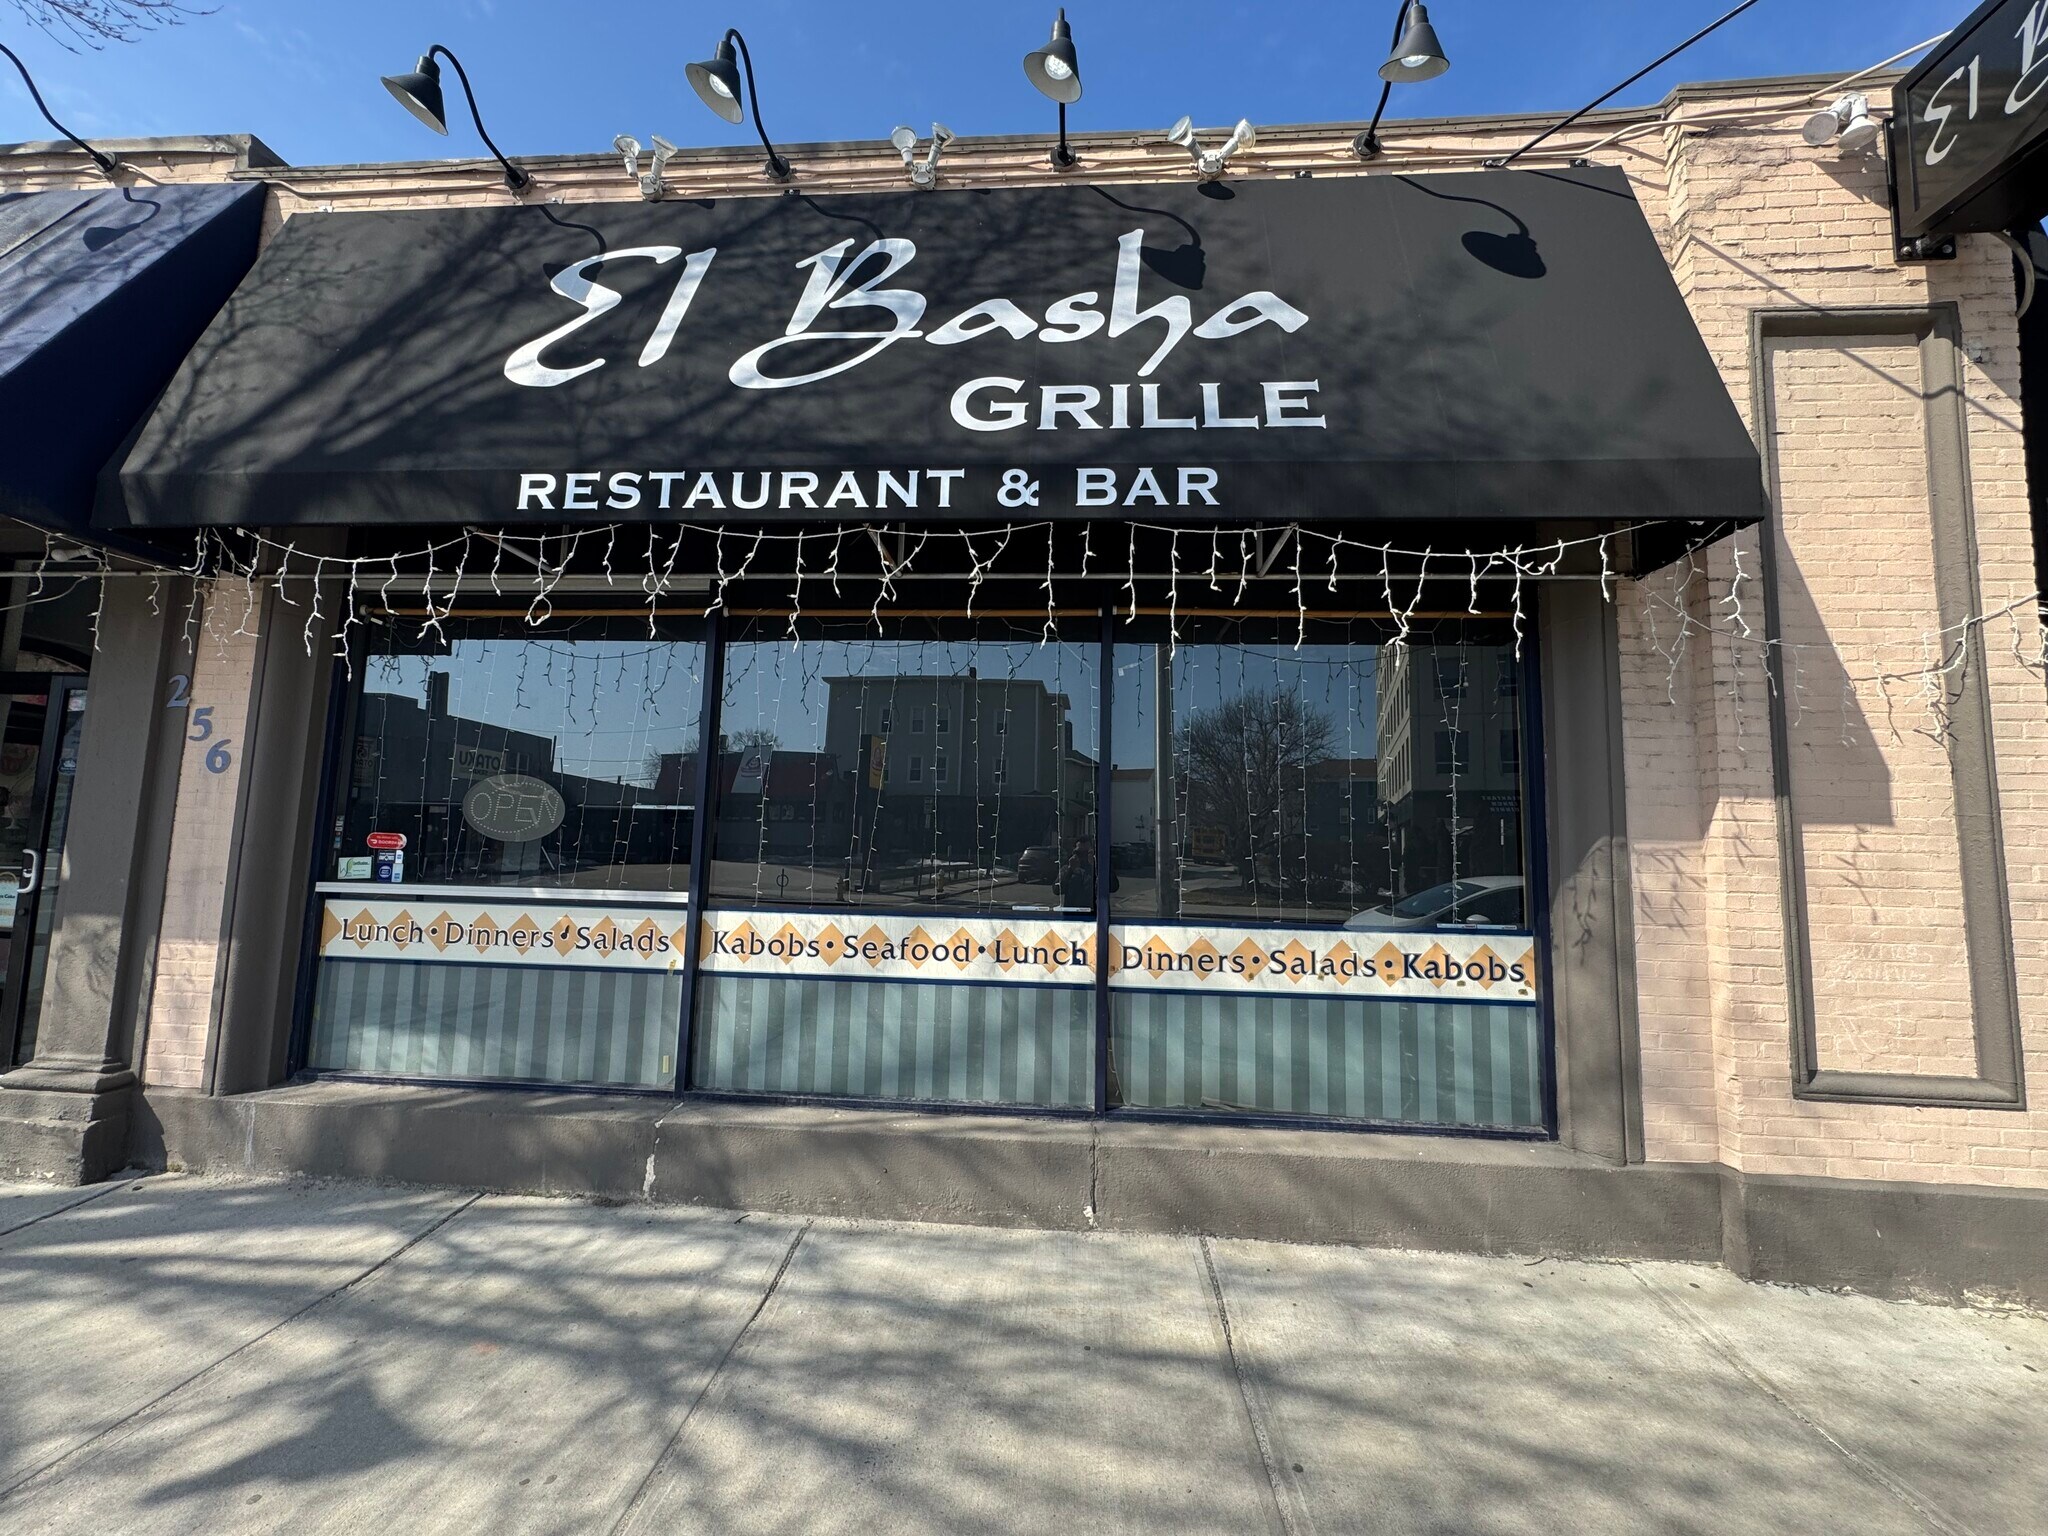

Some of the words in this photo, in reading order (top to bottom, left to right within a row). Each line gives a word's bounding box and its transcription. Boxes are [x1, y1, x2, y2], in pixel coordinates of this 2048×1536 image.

[1923, 54, 1980, 166] El
[503, 245, 717, 387] El
[729, 228, 1309, 389] Basha
[950, 376, 1327, 432] GRILLE
[516, 468, 966, 511] RESTAURANT
[997, 467, 1040, 508] &
[1075, 466, 1221, 507] BAR
[470, 792, 560, 824] OPEN
[341, 917, 425, 945] Lunch
[444, 920, 554, 948] Dinners
[574, 926, 670, 952] Salads
[711, 930, 820, 957] Kabobs
[843, 935, 971, 963] Seafood
[994, 939, 1089, 967] Lunch
[1120, 945, 1246, 973] Dinners
[1269, 949, 1378, 978] Salads
[1401, 952, 1528, 983] Kabobs
